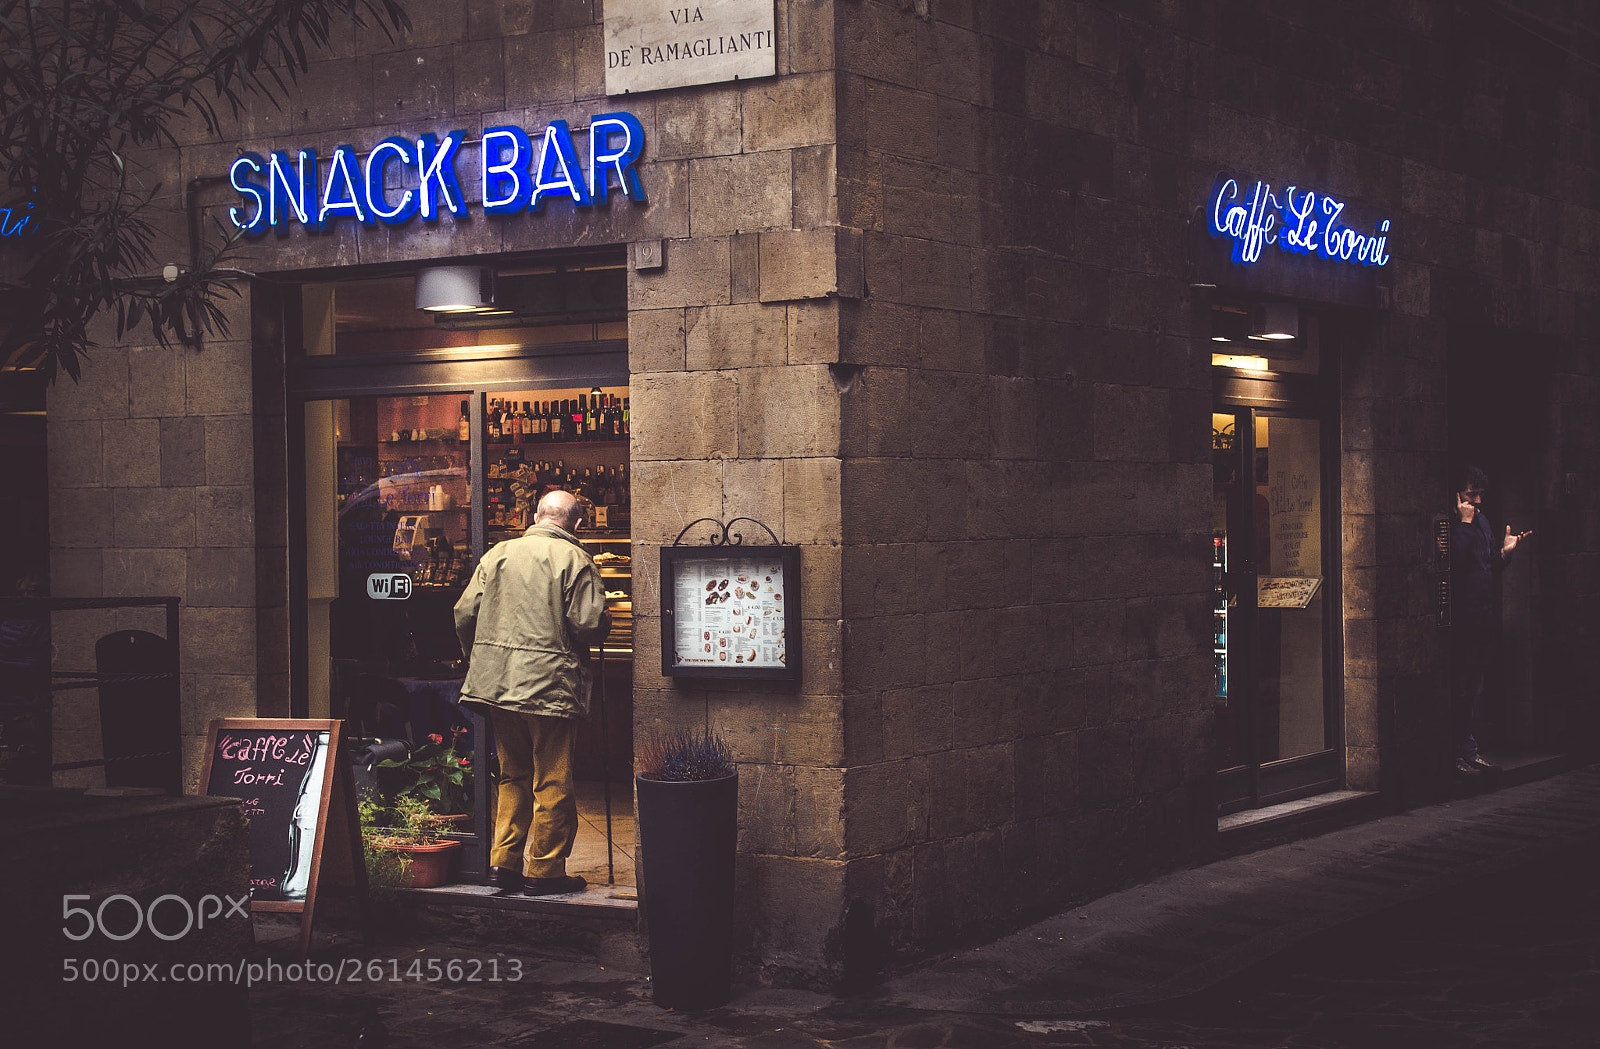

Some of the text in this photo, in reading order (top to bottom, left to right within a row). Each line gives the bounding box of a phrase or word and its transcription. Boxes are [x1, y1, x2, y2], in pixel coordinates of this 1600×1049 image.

[669, 7, 704, 25] VIA
[641, 30, 772, 65] RAMAGLIANTI
[229, 112, 646, 236] SNACK BAR
[1284, 184, 1320, 252] Le
[1321, 195, 1392, 267] Torri
[398, 484, 436, 506] Torri
[233, 767, 285, 787] Torri
